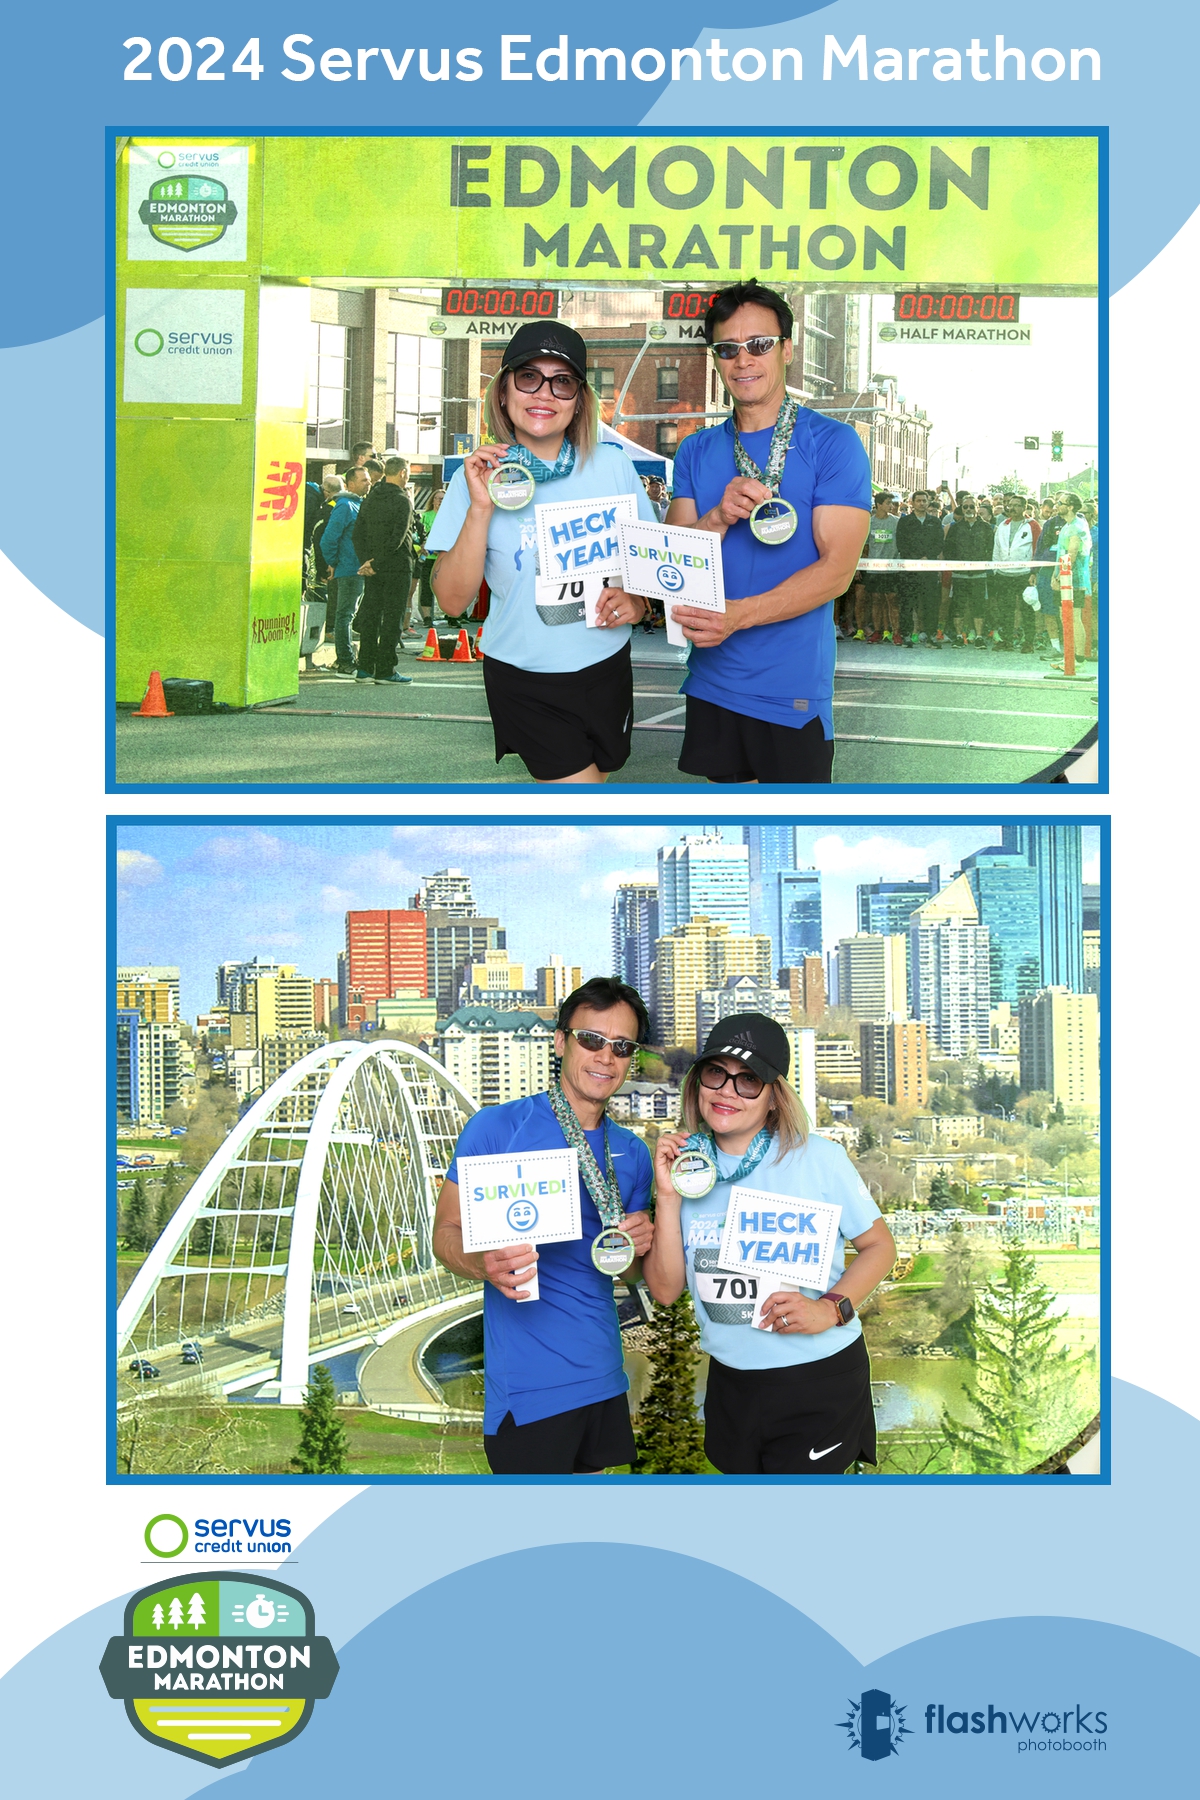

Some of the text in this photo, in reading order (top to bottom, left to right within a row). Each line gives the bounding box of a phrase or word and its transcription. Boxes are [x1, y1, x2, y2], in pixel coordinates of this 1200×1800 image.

[178, 152, 219, 161] servus
[450, 145, 990, 210] EDMONTON
[149, 203, 226, 213] EDMONTON
[160, 214, 215, 222] MARATHON
[522, 223, 907, 271] MARATHON
[465, 321, 519, 335] ARMY
[900, 328, 1031, 341] HALF MARATHON
[168, 332, 233, 345] servus
[168, 345, 233, 355] credit union
[549, 507, 618, 547] HECK
[663, 535, 669, 547] I
[629, 544, 710, 571] SURVIVED!
[257, 613, 290, 643] Running
[728, 1038, 757, 1050] adidas
[516, 1164, 522, 1179] I
[473, 1179, 567, 1202] SURVIVED!
[690, 1219, 718, 1230] 2024
[738, 1211, 818, 1236] HECK
[737, 1239, 820, 1265] YEAH!
